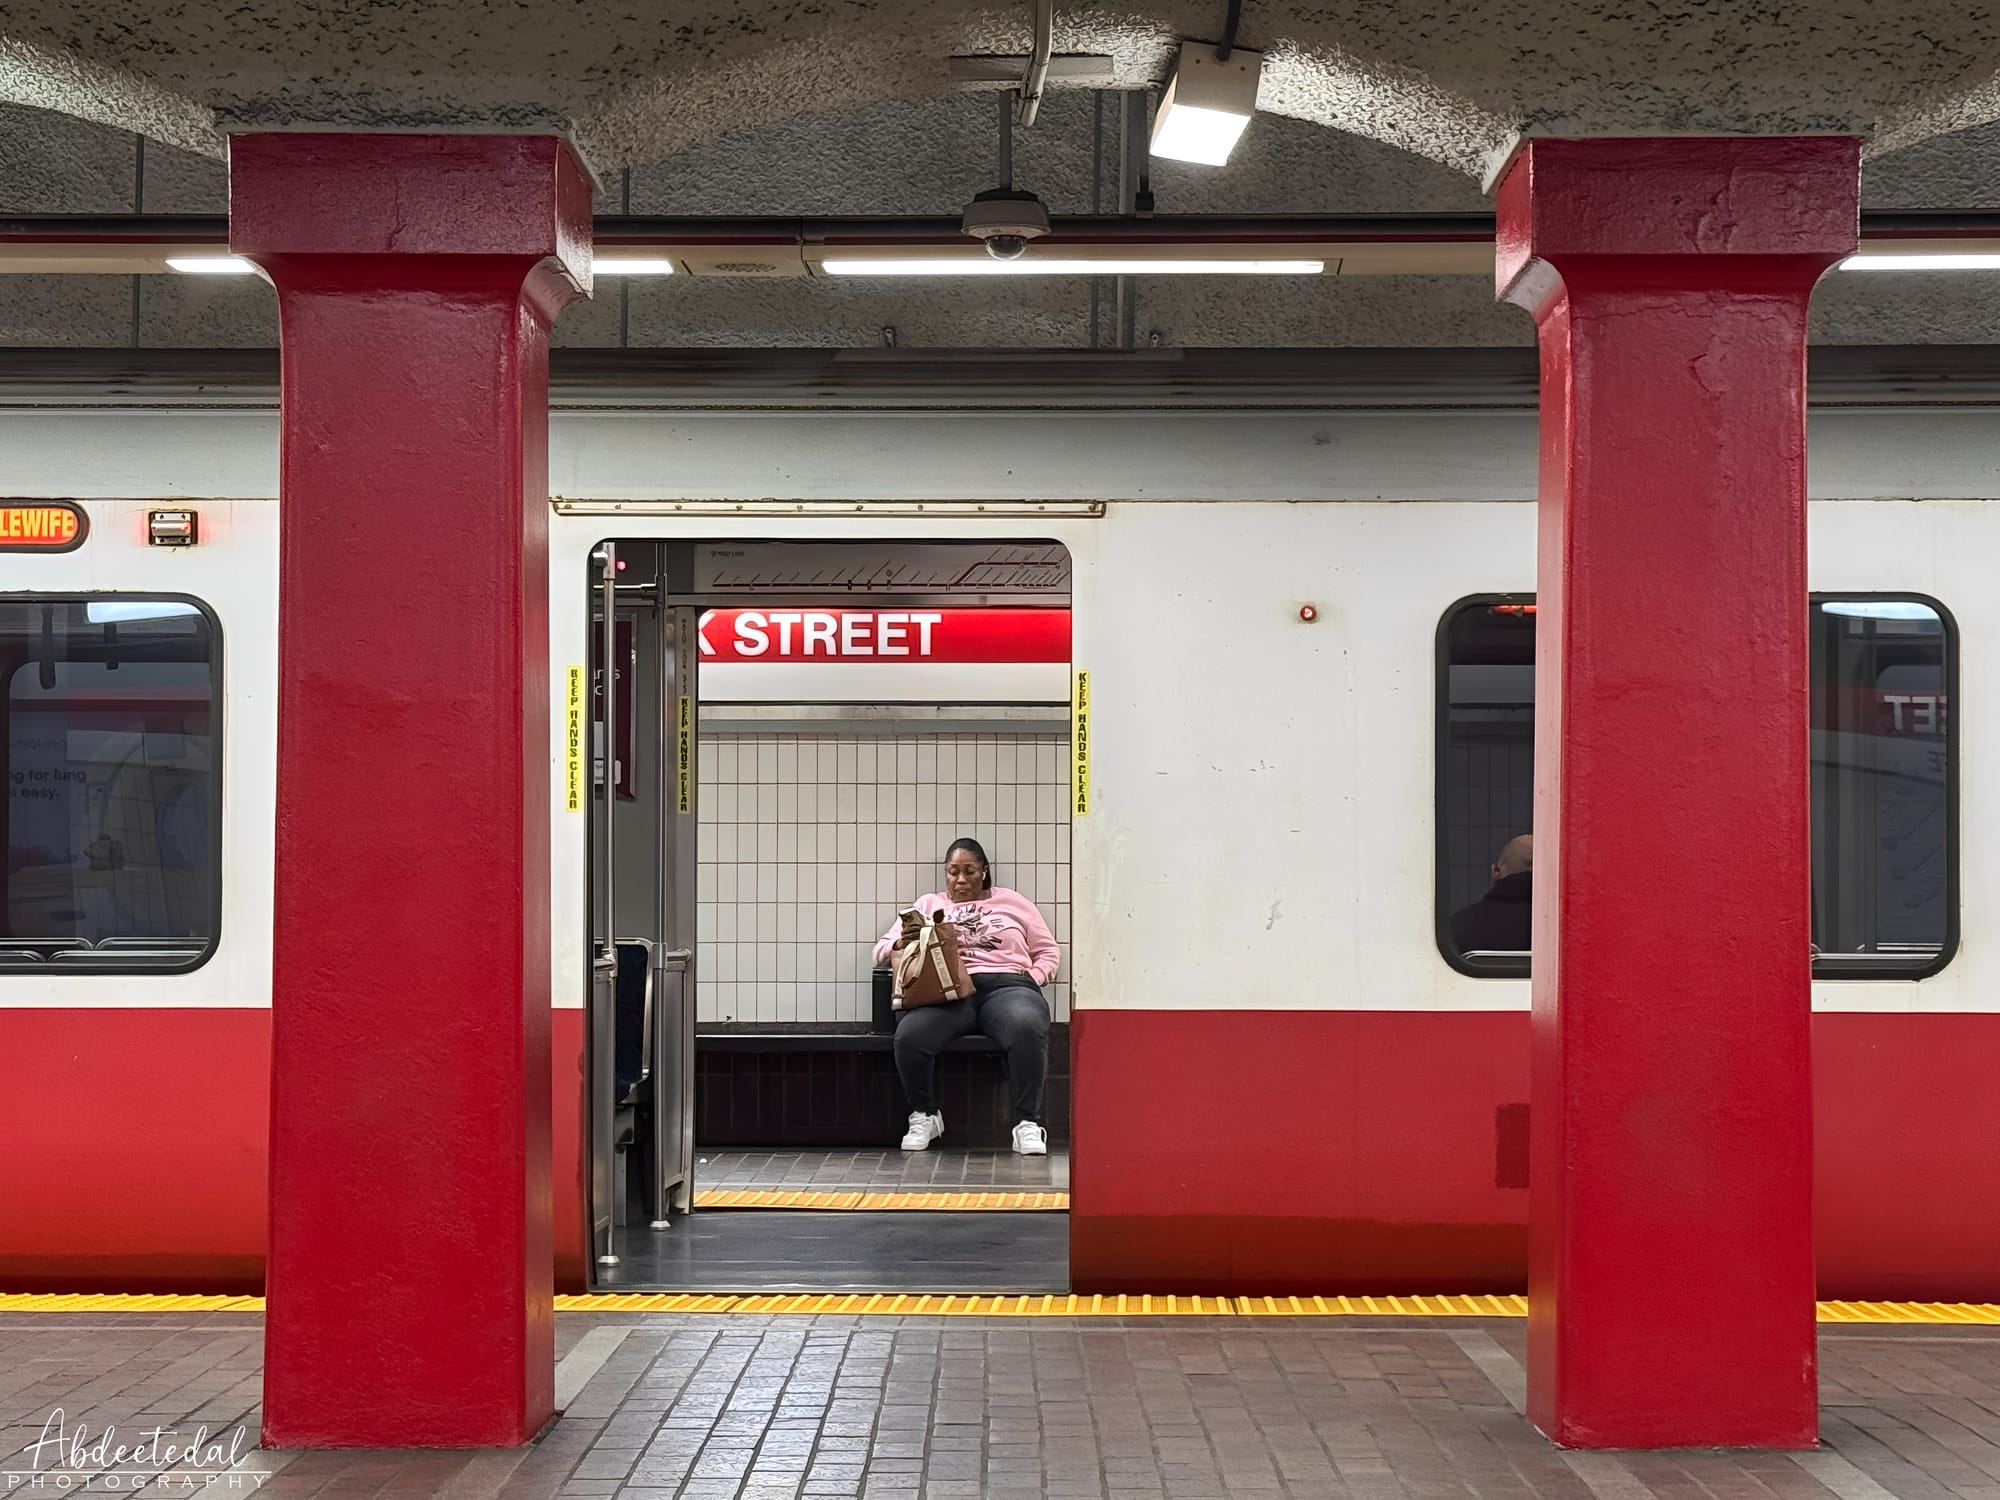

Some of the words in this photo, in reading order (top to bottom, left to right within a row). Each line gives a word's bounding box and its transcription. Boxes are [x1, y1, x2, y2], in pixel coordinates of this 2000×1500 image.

[0, 510, 74, 537] LEWIFE
[733, 612, 942, 657] STREET
[570, 669, 578, 706] KEEP
[1078, 673, 1087, 710] KEEP
[569, 710, 578, 758] HANDS
[680, 731, 688, 770] HANDS
[1077, 714, 1087, 761] HANDS
[29, 768, 49, 781] for
[569, 761, 577, 809] CLEAR
[680, 772, 688, 811] CLEAR
[1077, 765, 1086, 813] CLEAR
[21, 788, 60, 801] easy.
